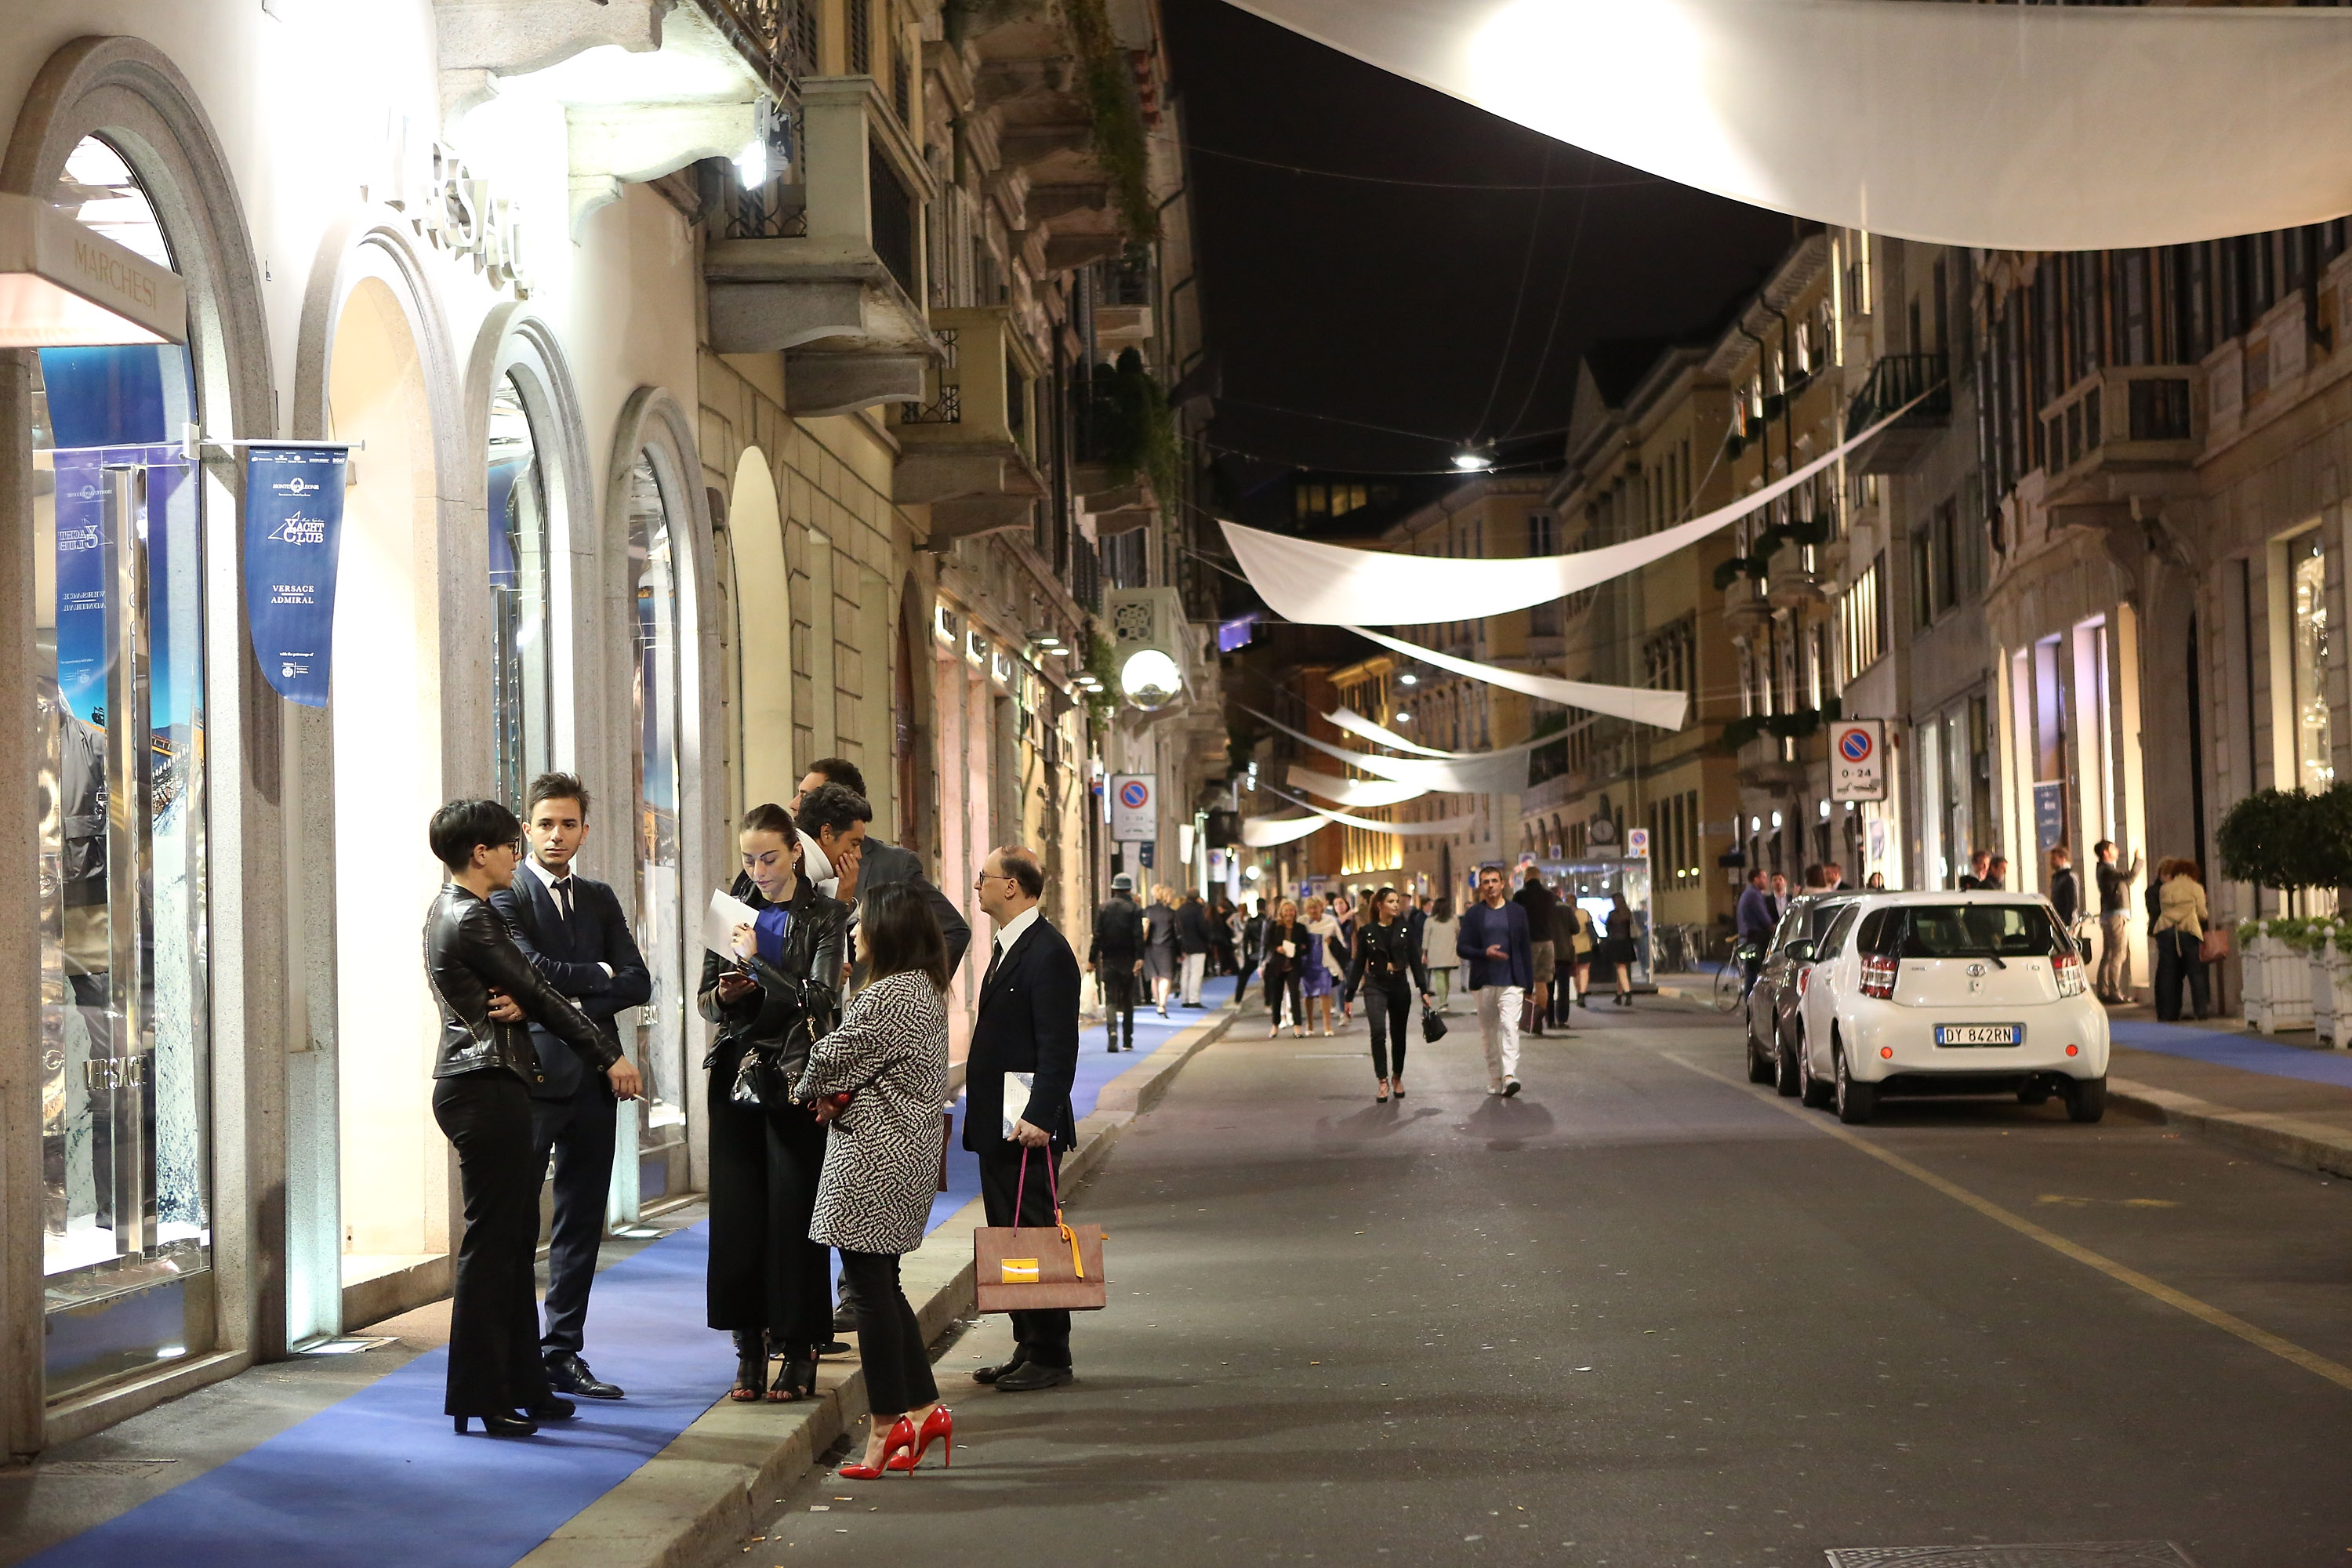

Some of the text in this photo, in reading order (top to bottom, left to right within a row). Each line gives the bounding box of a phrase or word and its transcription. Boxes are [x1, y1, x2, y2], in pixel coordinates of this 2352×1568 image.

[74, 238, 156, 310] MARCHESI
[285, 518, 325, 532] YACHT
[284, 527, 324, 543] CLUB
[1842, 769, 1849, 778] 0
[1857, 769, 1871, 778] 24
[1946, 1029, 1962, 1042] DY
[1969, 1029, 2011, 1042] 842RN
[82, 1055, 147, 1091] VERSACE
